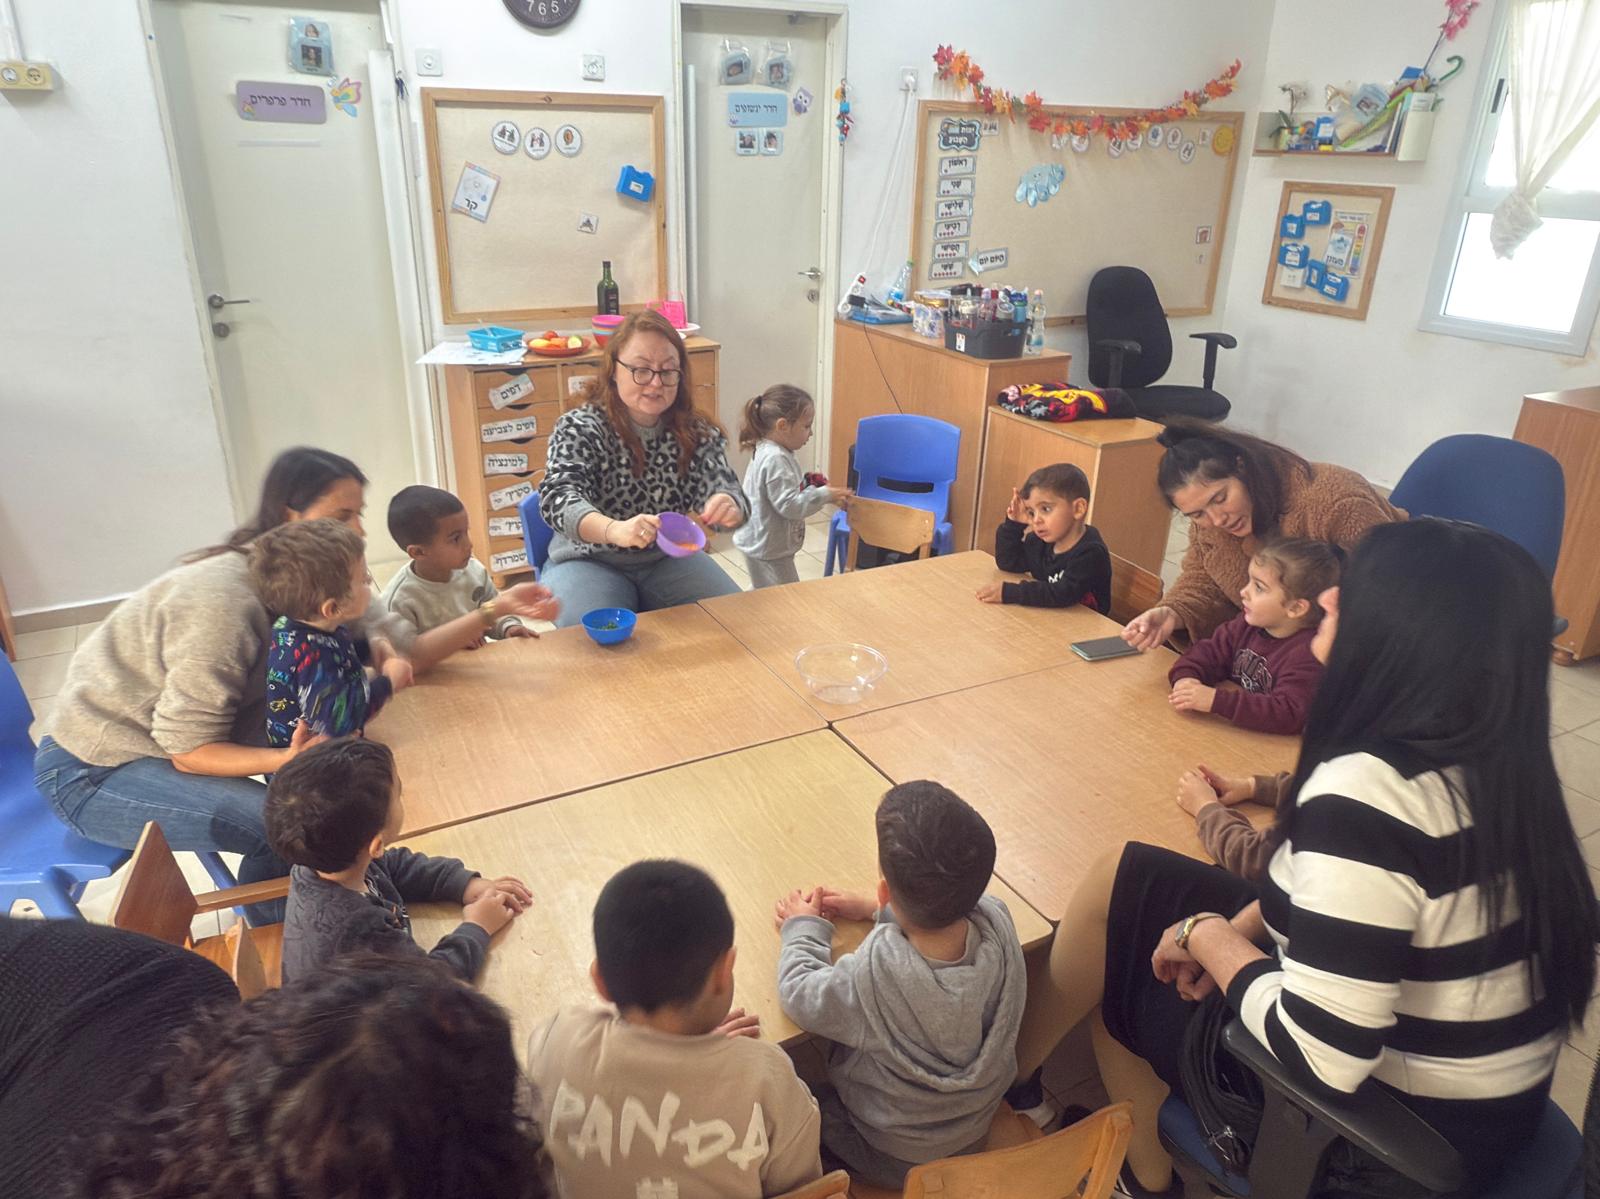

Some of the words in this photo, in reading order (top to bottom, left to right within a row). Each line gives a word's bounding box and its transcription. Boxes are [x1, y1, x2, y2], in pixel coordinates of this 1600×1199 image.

[538, 3, 547, 15] 6
[551, 0, 560, 13] 5
[250, 94, 287, 106] פרפרים
[290, 97, 311, 107] חדר
[763, 104, 778, 113] חדר
[465, 198, 478, 210] קר
[500, 384, 522, 400] דפים
[482, 423, 514, 436] לצביעה
[516, 420, 535, 431] דפים
[487, 455, 525, 467] למינציה
[549, 1078, 770, 1171] PANDA
